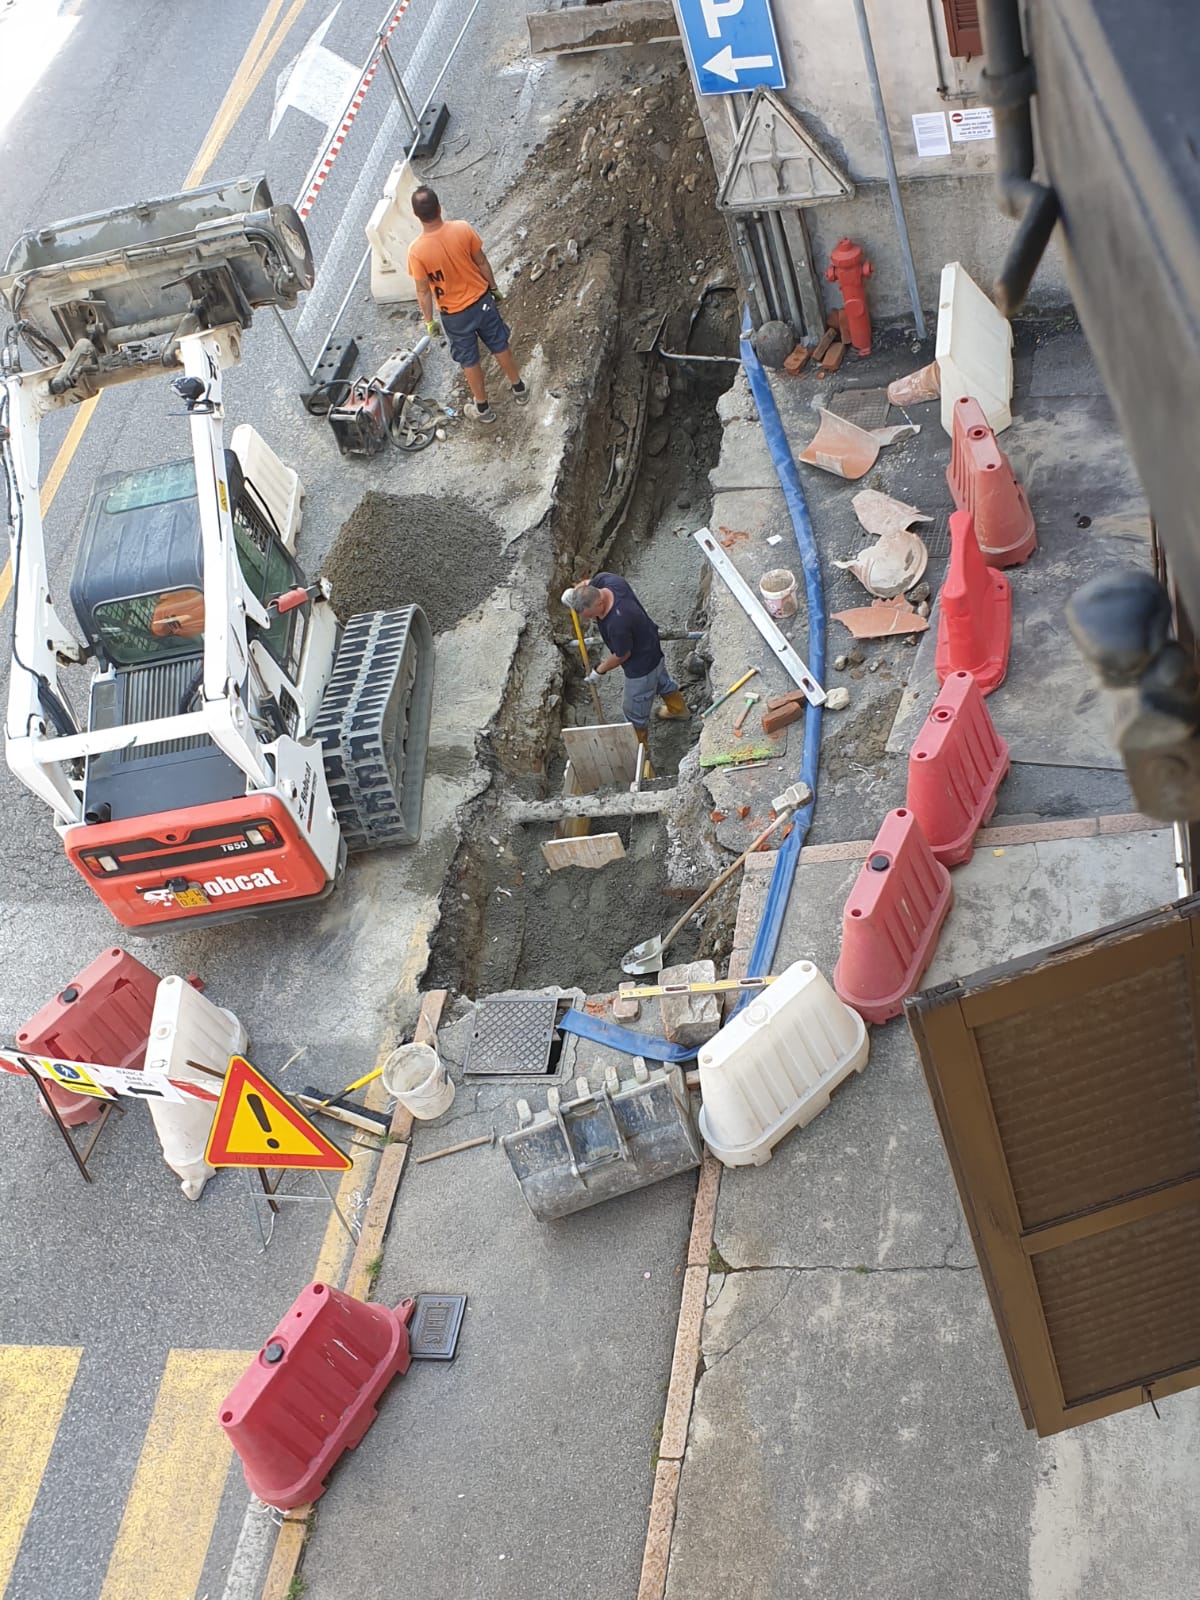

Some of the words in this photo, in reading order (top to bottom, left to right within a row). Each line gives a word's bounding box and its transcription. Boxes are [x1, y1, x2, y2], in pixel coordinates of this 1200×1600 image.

[701, 0, 744, 38] P
[220, 841, 248, 852] T650
[202, 868, 281, 896] obcat
